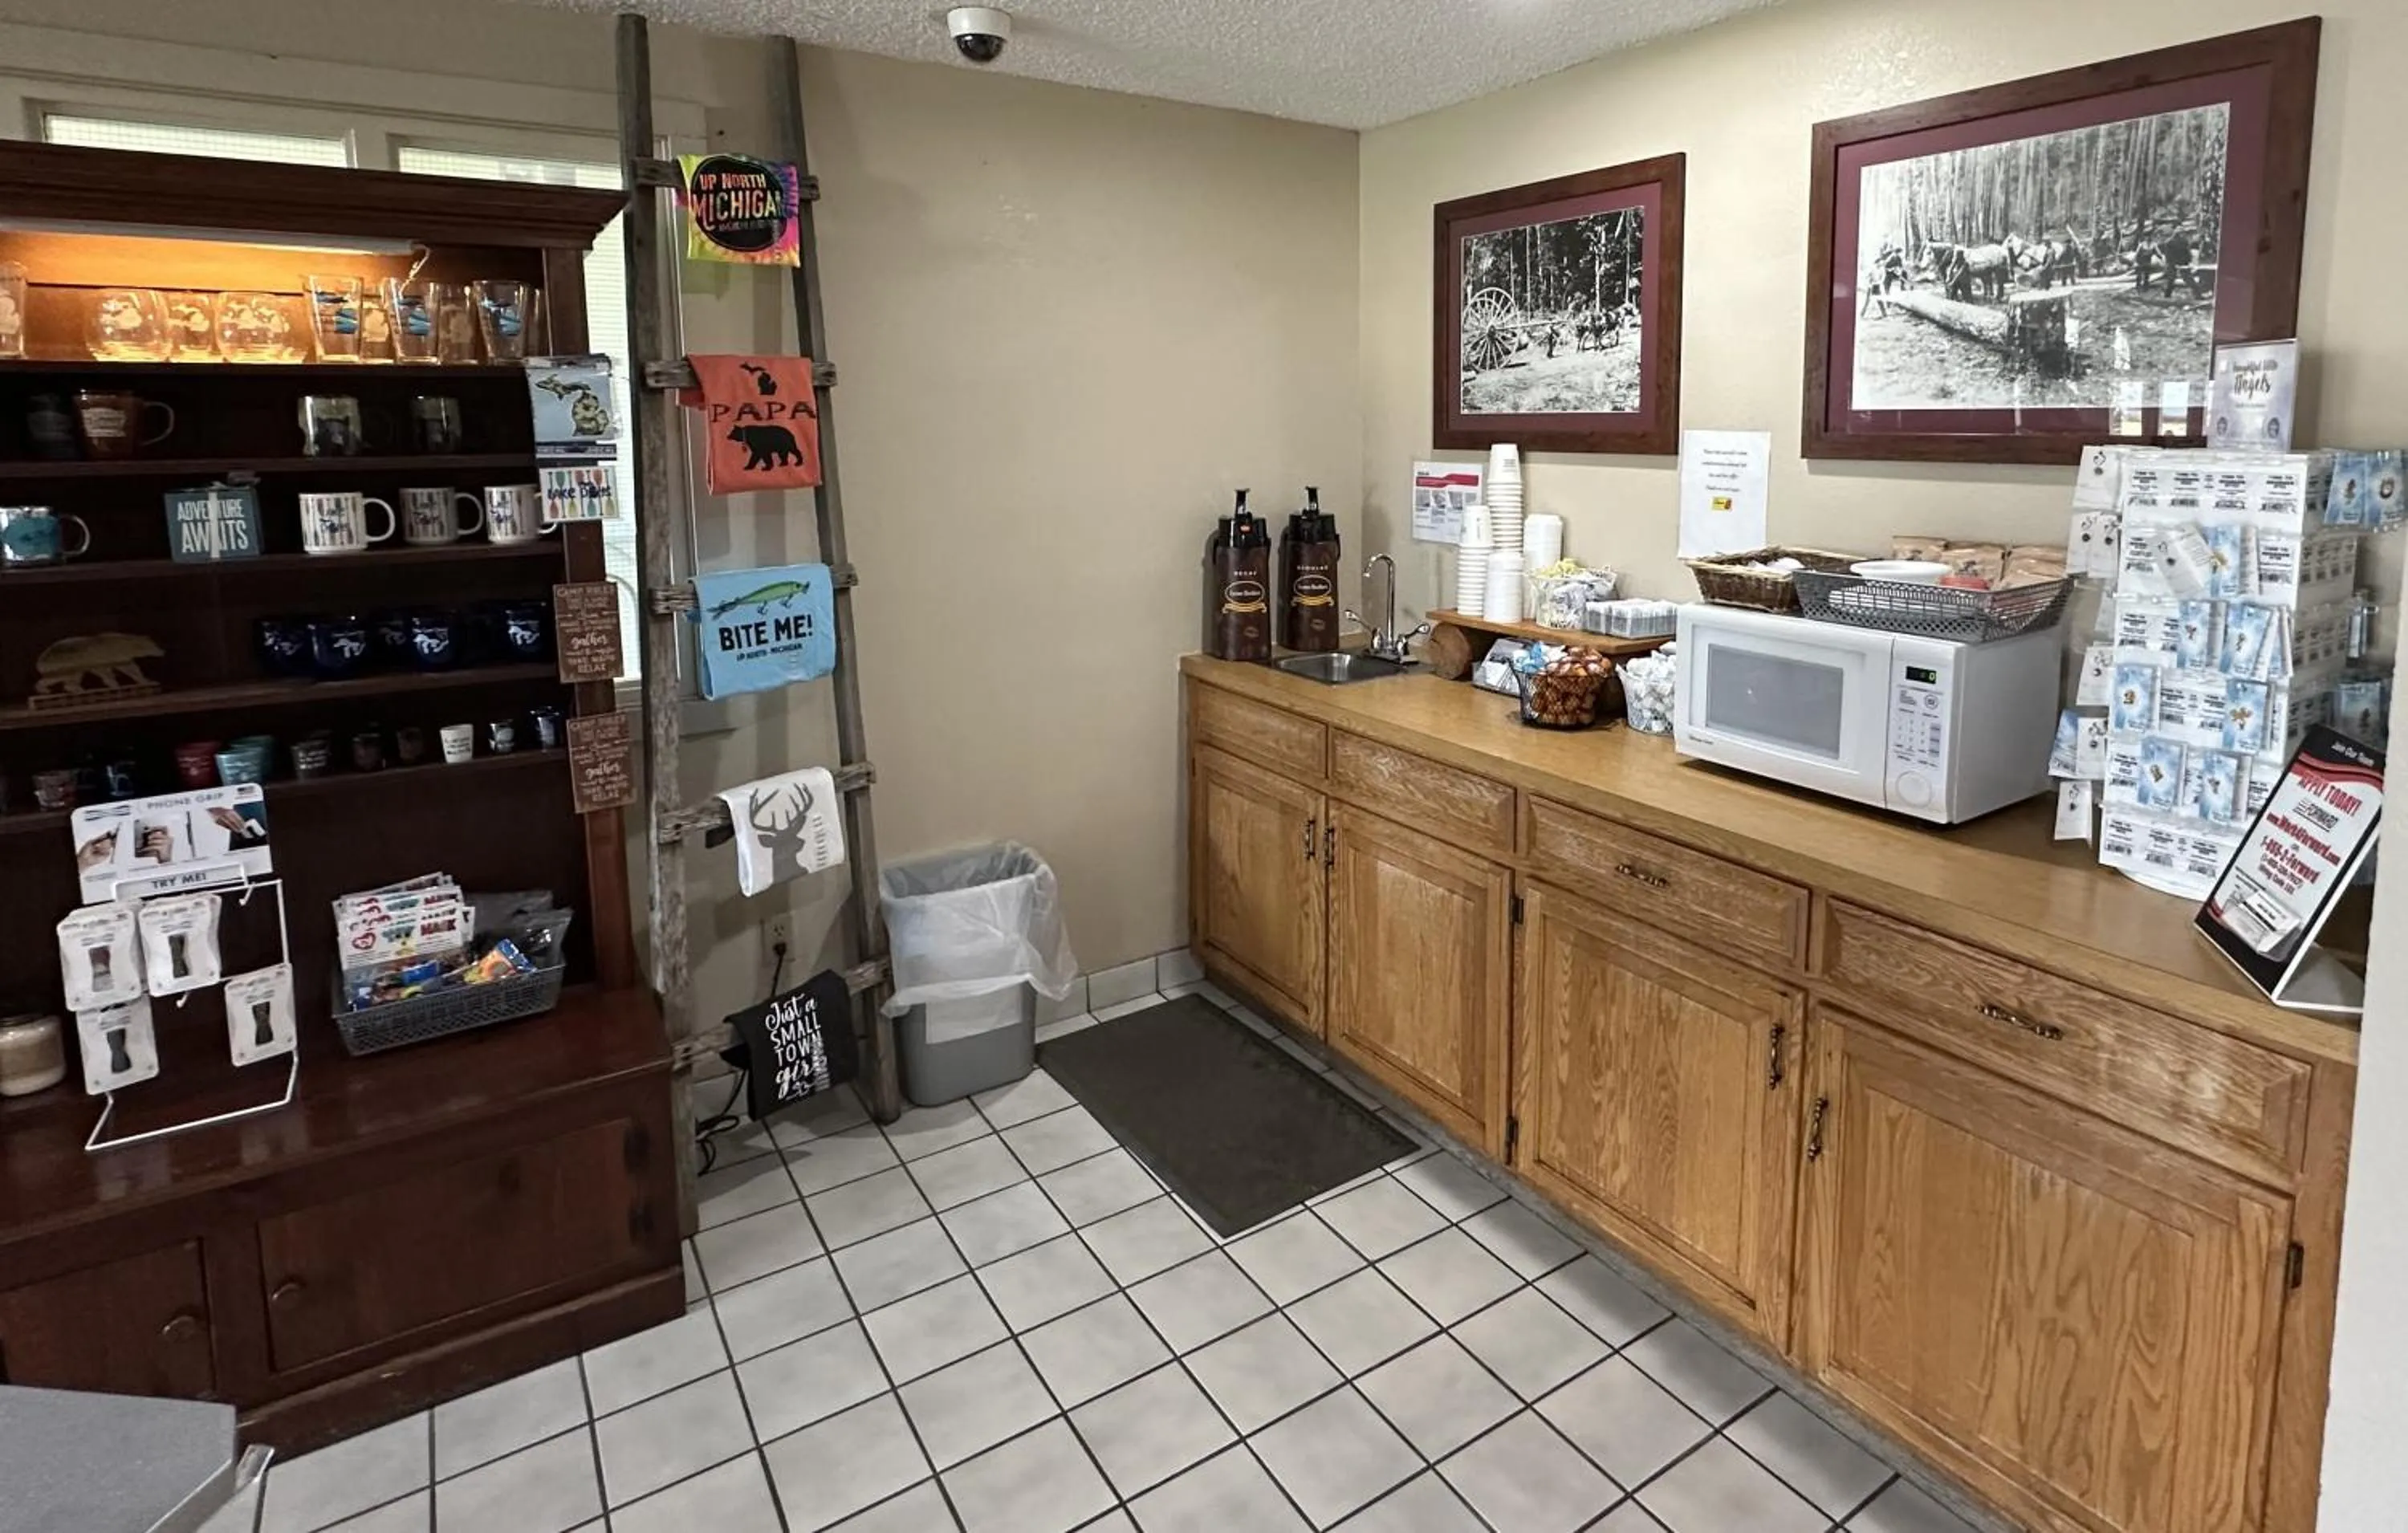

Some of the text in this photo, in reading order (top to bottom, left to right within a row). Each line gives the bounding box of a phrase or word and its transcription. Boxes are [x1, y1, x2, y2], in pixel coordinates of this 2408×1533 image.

[700, 173, 767, 191] UP NORTH
[710, 401, 817, 423] PAPA
[181, 519, 249, 553] AWITS
[719, 613, 814, 653] BITE ME!
[147, 791, 225, 810] PHONE GRIP
[2297, 773, 2364, 816] APPLY TODAY!
[151, 872, 207, 890] TRY ME!
[765, 993, 805, 1031] Just
[771, 1011, 821, 1050] SMALL
[775, 1030, 823, 1067] TOWN
